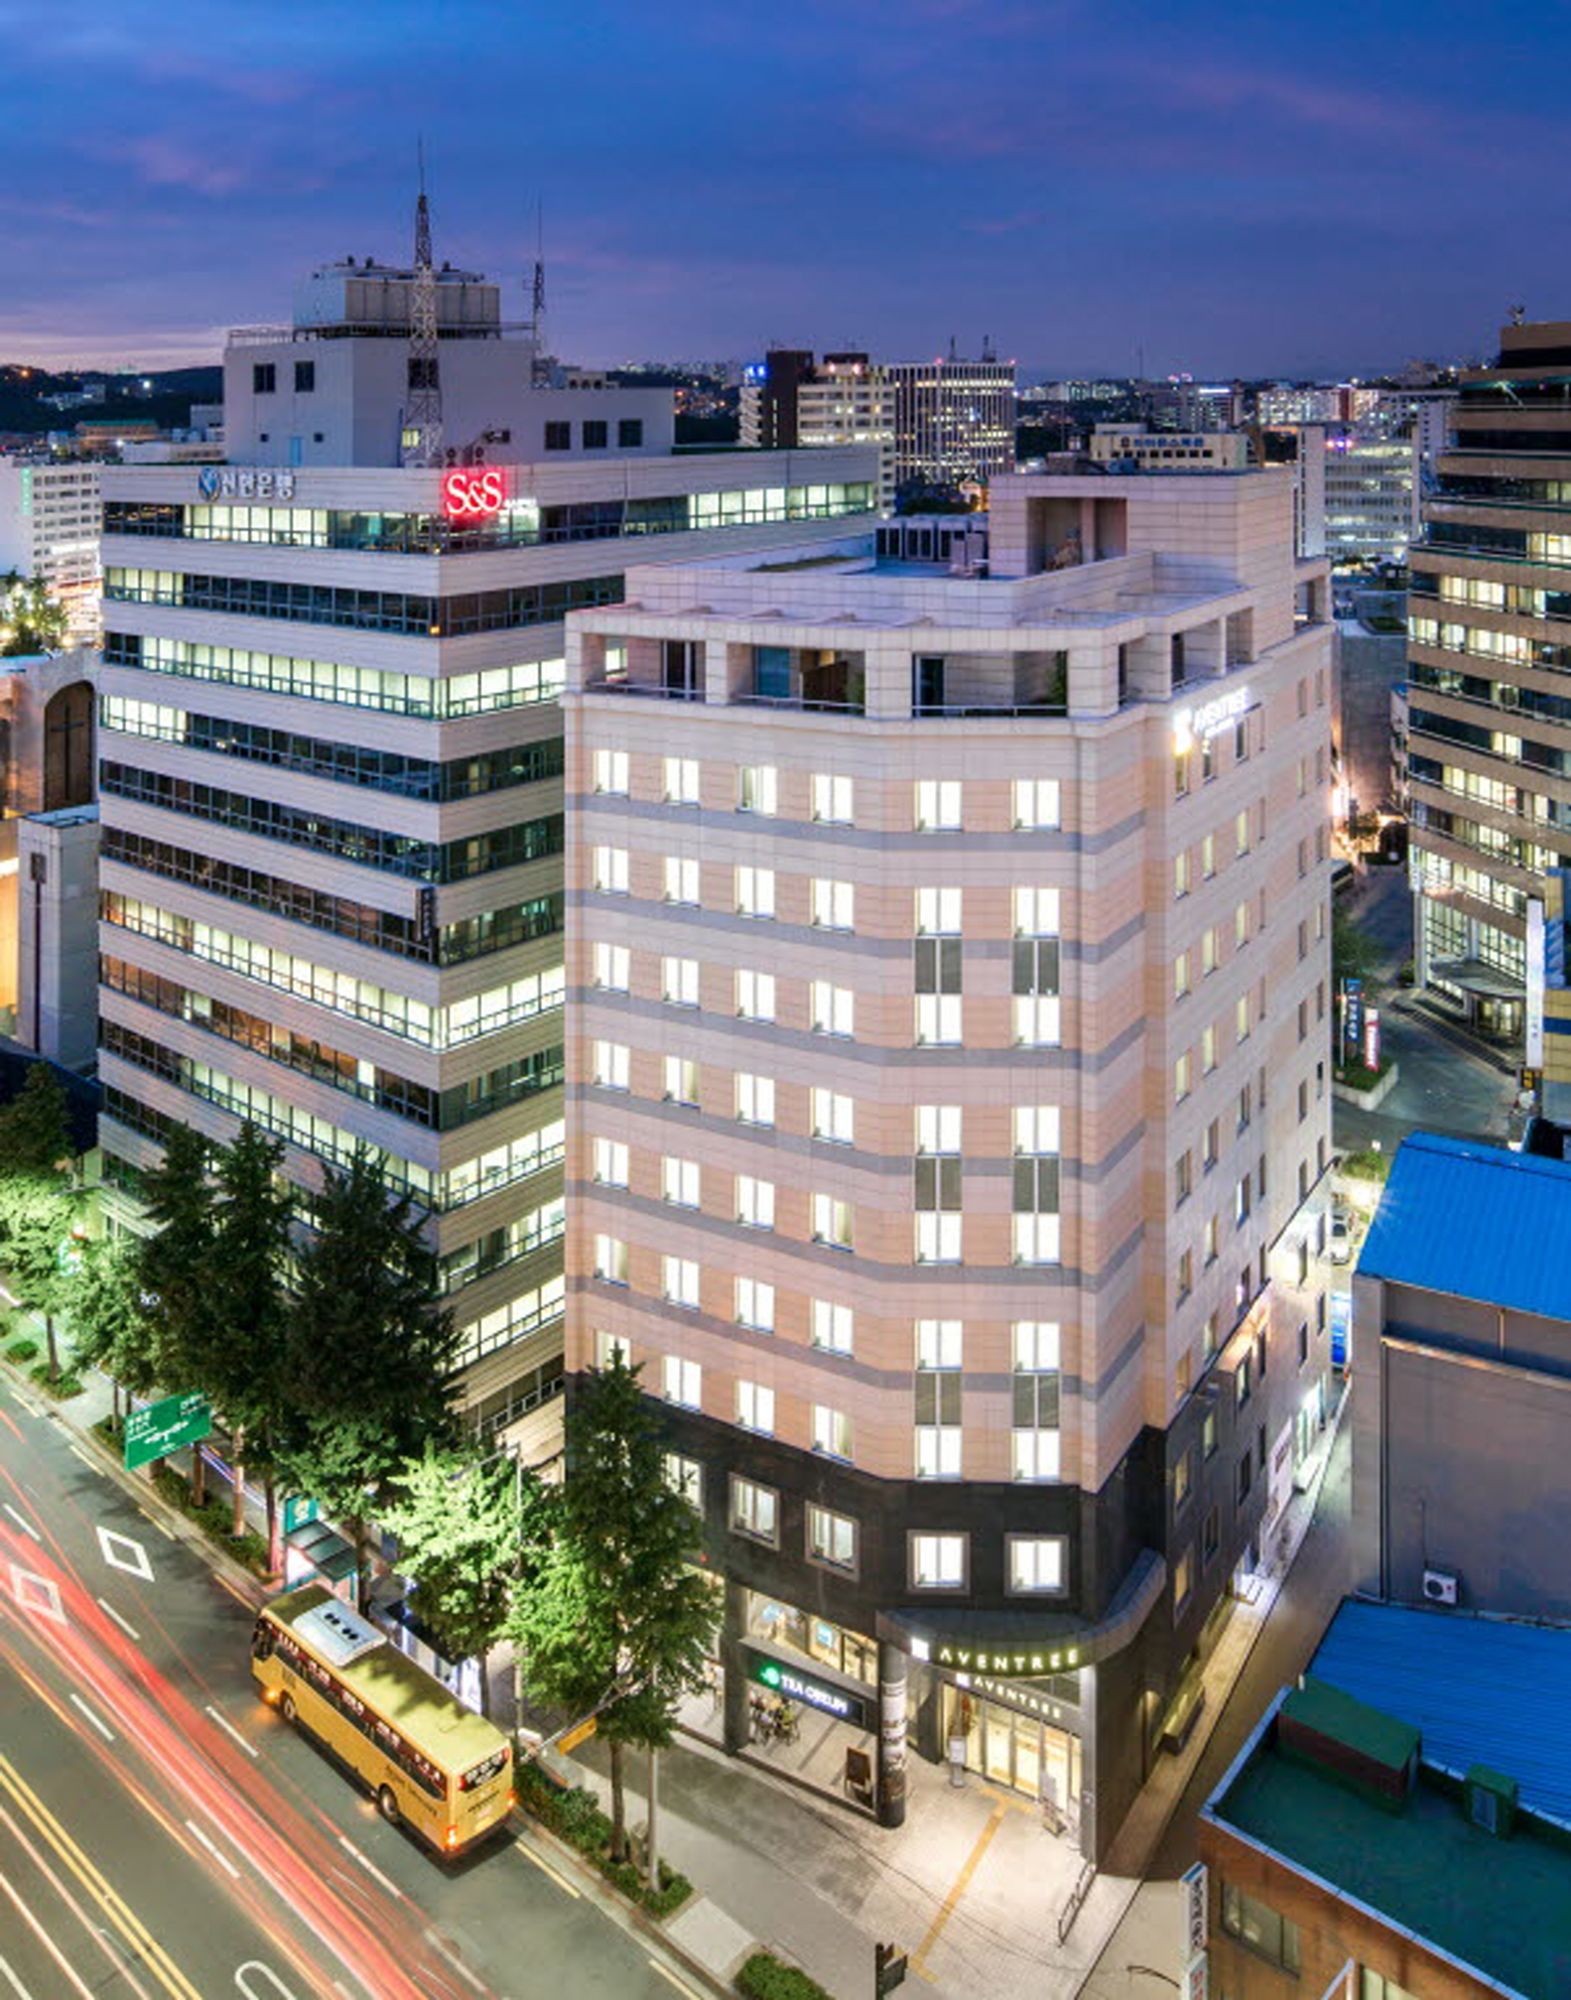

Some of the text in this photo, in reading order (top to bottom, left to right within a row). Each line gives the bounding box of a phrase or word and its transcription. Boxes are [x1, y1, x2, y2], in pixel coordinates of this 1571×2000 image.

[445, 471, 502, 514] S&S
[939, 1648, 1079, 1672] AVENTREE
[974, 1676, 1061, 1719] AVENTREE
